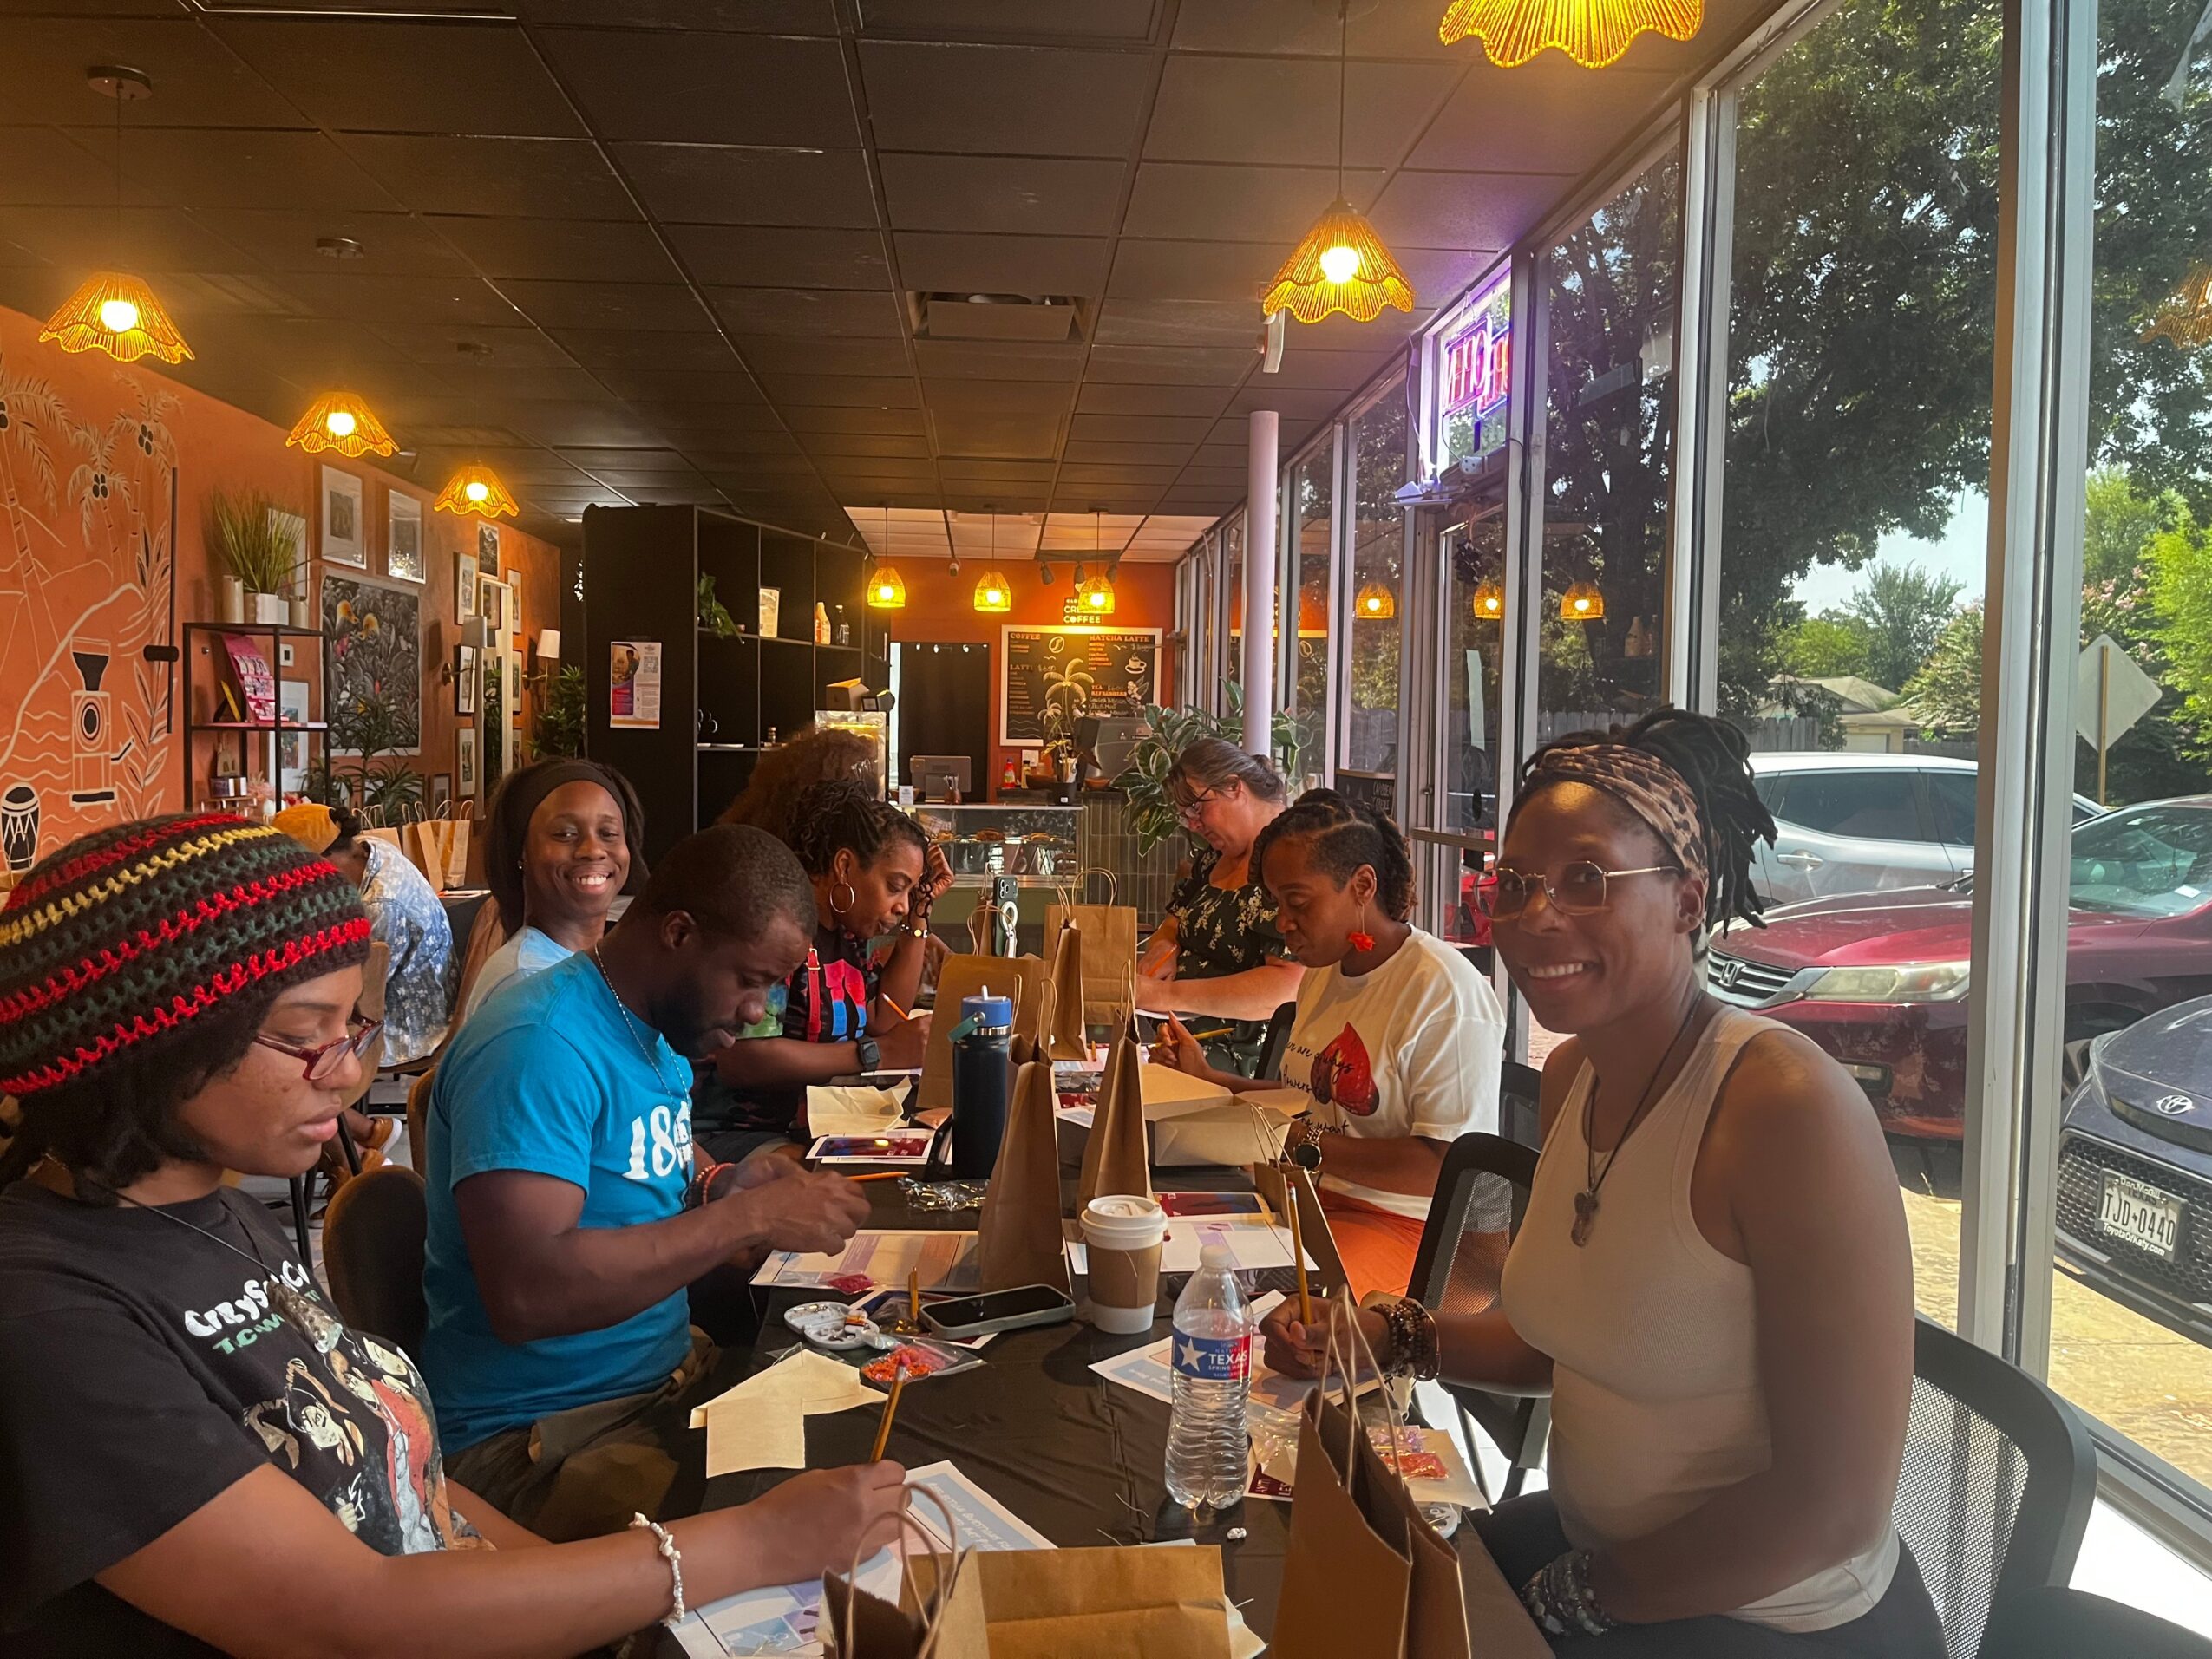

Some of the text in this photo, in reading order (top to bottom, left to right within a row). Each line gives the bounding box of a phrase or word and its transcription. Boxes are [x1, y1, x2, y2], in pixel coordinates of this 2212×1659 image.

[1063, 615, 1101, 624] COFFEE
[1317, 1119, 1350, 1138] want
[2128, 1187, 2157, 1206] TEXAS
[2103, 1222, 2166, 1257] ToyotaOfKaty.com
[1208, 1350, 1247, 1366] TEXAS
